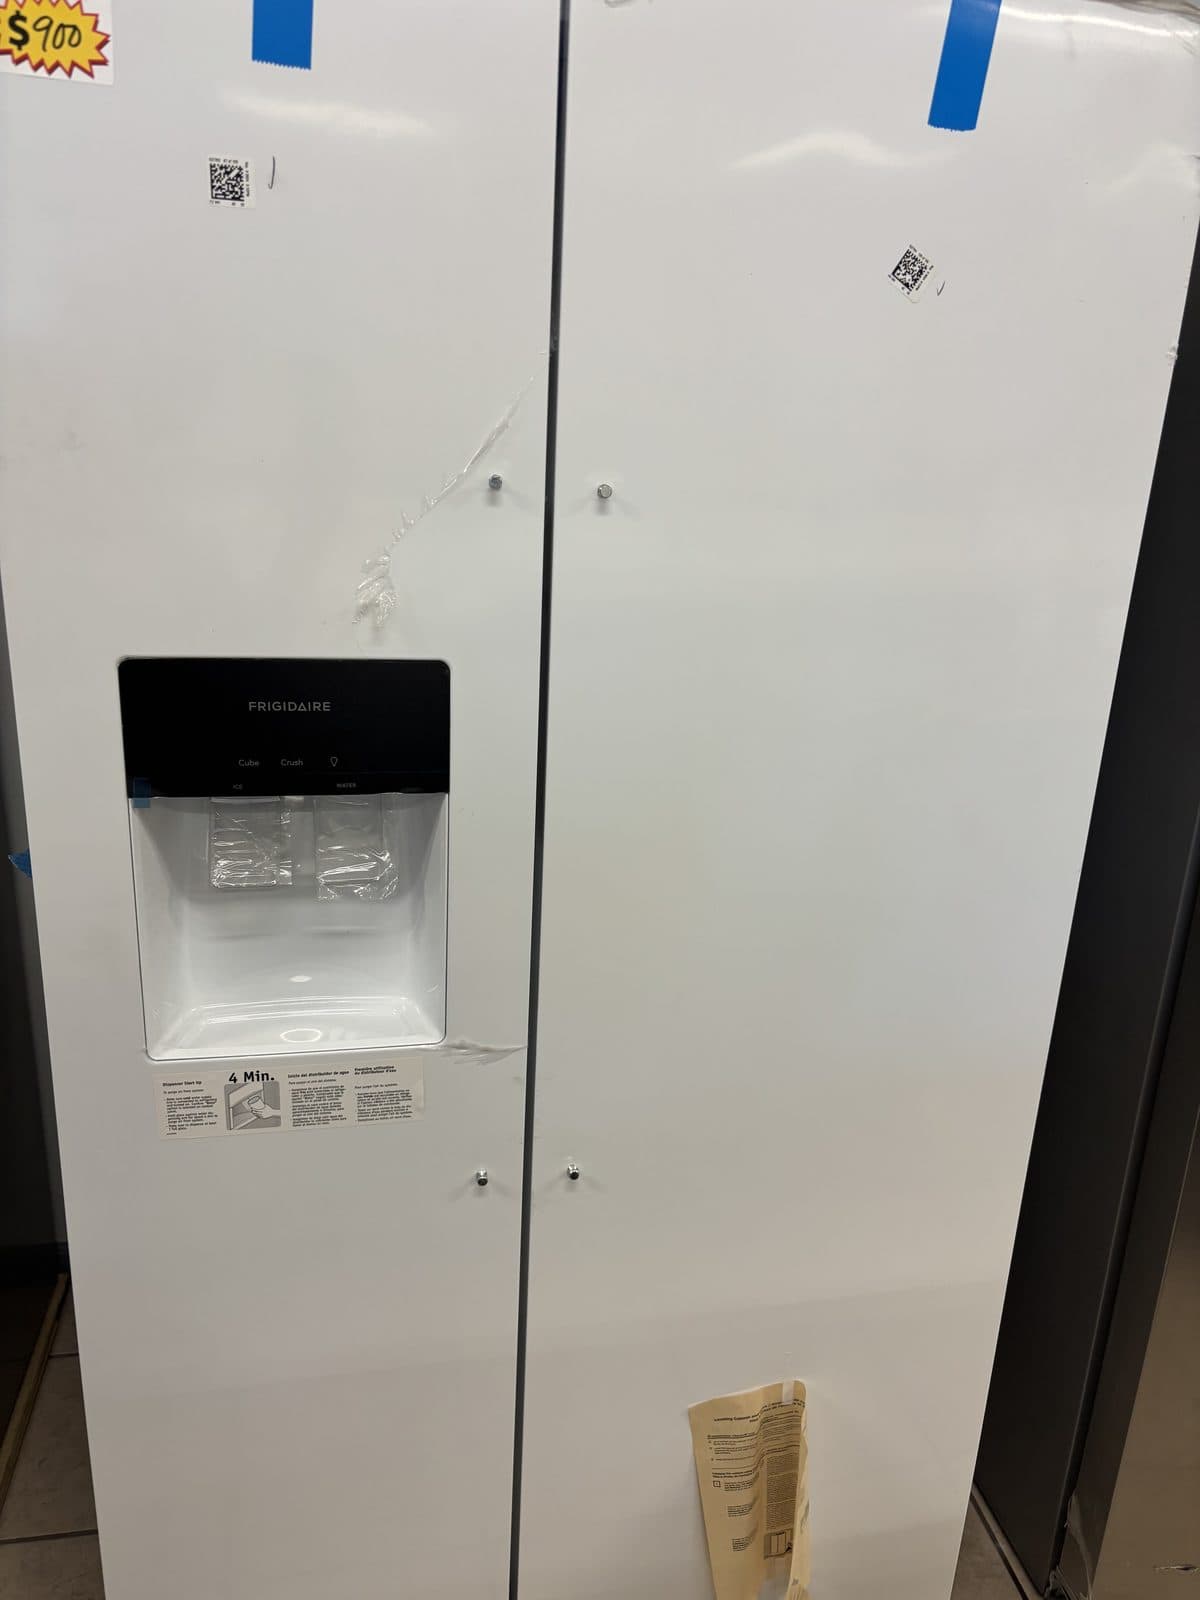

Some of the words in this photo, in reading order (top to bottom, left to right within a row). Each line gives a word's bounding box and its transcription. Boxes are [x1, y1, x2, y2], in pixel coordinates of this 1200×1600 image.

[8, 10, 82, 52] $900
[248, 701, 331, 712] FRIGIDAIRE
[238, 759, 260, 767] Cube
[280, 758, 304, 767] Crush
[228, 1072, 238, 1084] 4
[243, 1070, 275, 1083] Min.
